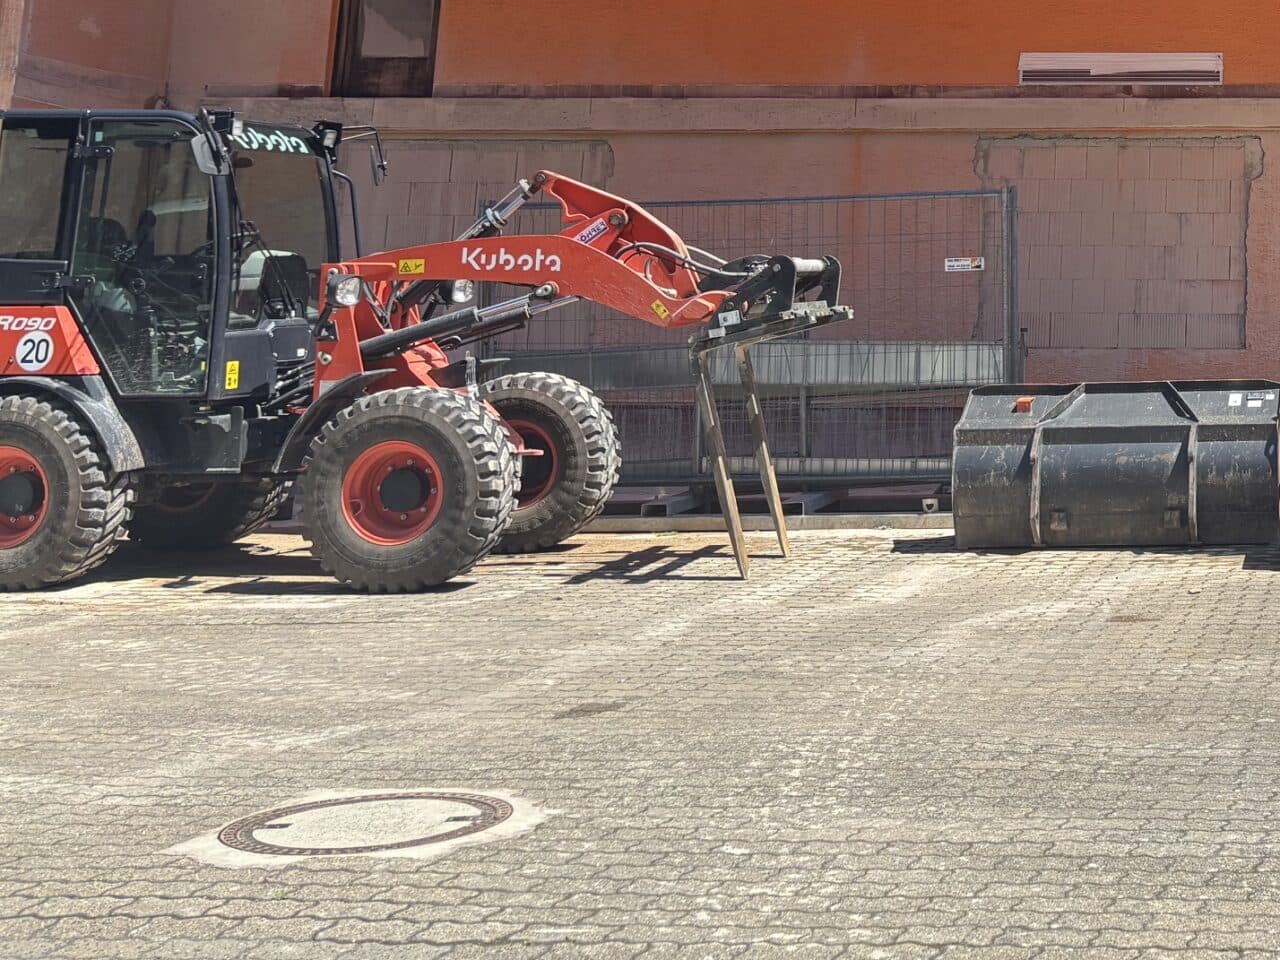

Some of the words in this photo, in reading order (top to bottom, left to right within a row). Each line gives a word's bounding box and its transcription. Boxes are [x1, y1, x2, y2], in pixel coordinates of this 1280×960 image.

[461, 247, 562, 272] Kubota
[0, 315, 57, 331] R090
[20, 338, 50, 364] 20
